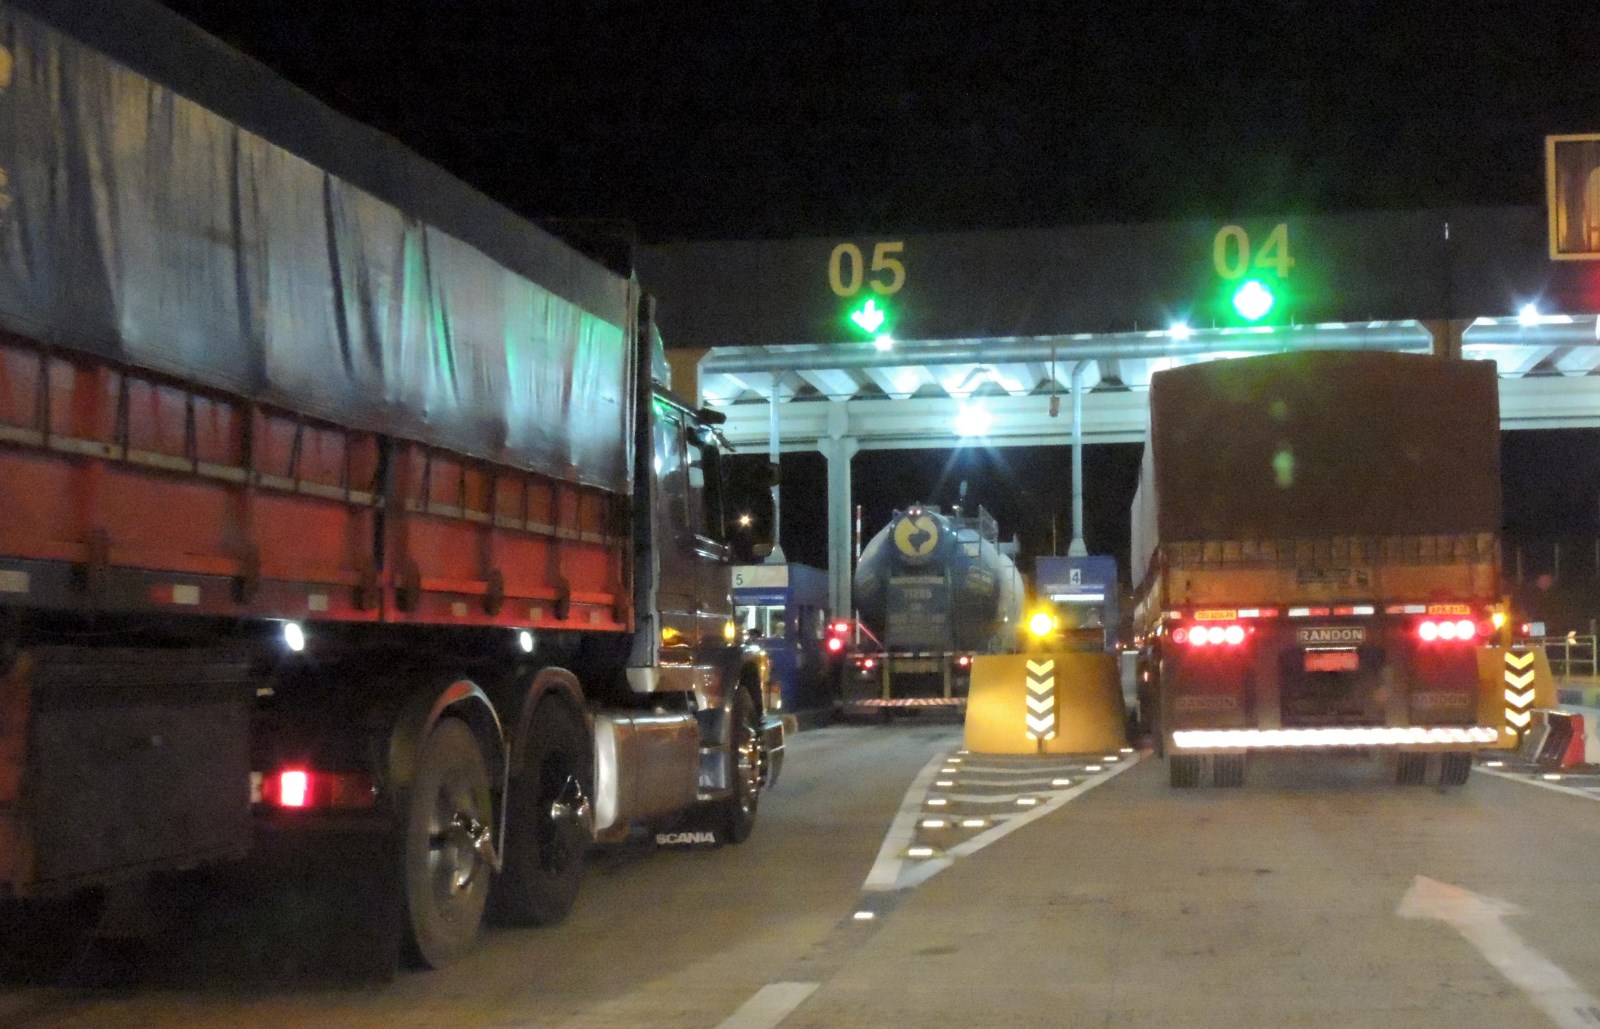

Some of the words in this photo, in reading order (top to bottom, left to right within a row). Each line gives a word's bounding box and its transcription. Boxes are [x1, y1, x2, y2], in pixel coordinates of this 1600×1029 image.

[1213, 224, 1295, 279] 04
[829, 242, 905, 297] 05
[735, 573, 744, 586] 5
[1071, 571, 1080, 584] 4
[1299, 629, 1363, 641] RANDON
[656, 831, 716, 845] SCANIA
